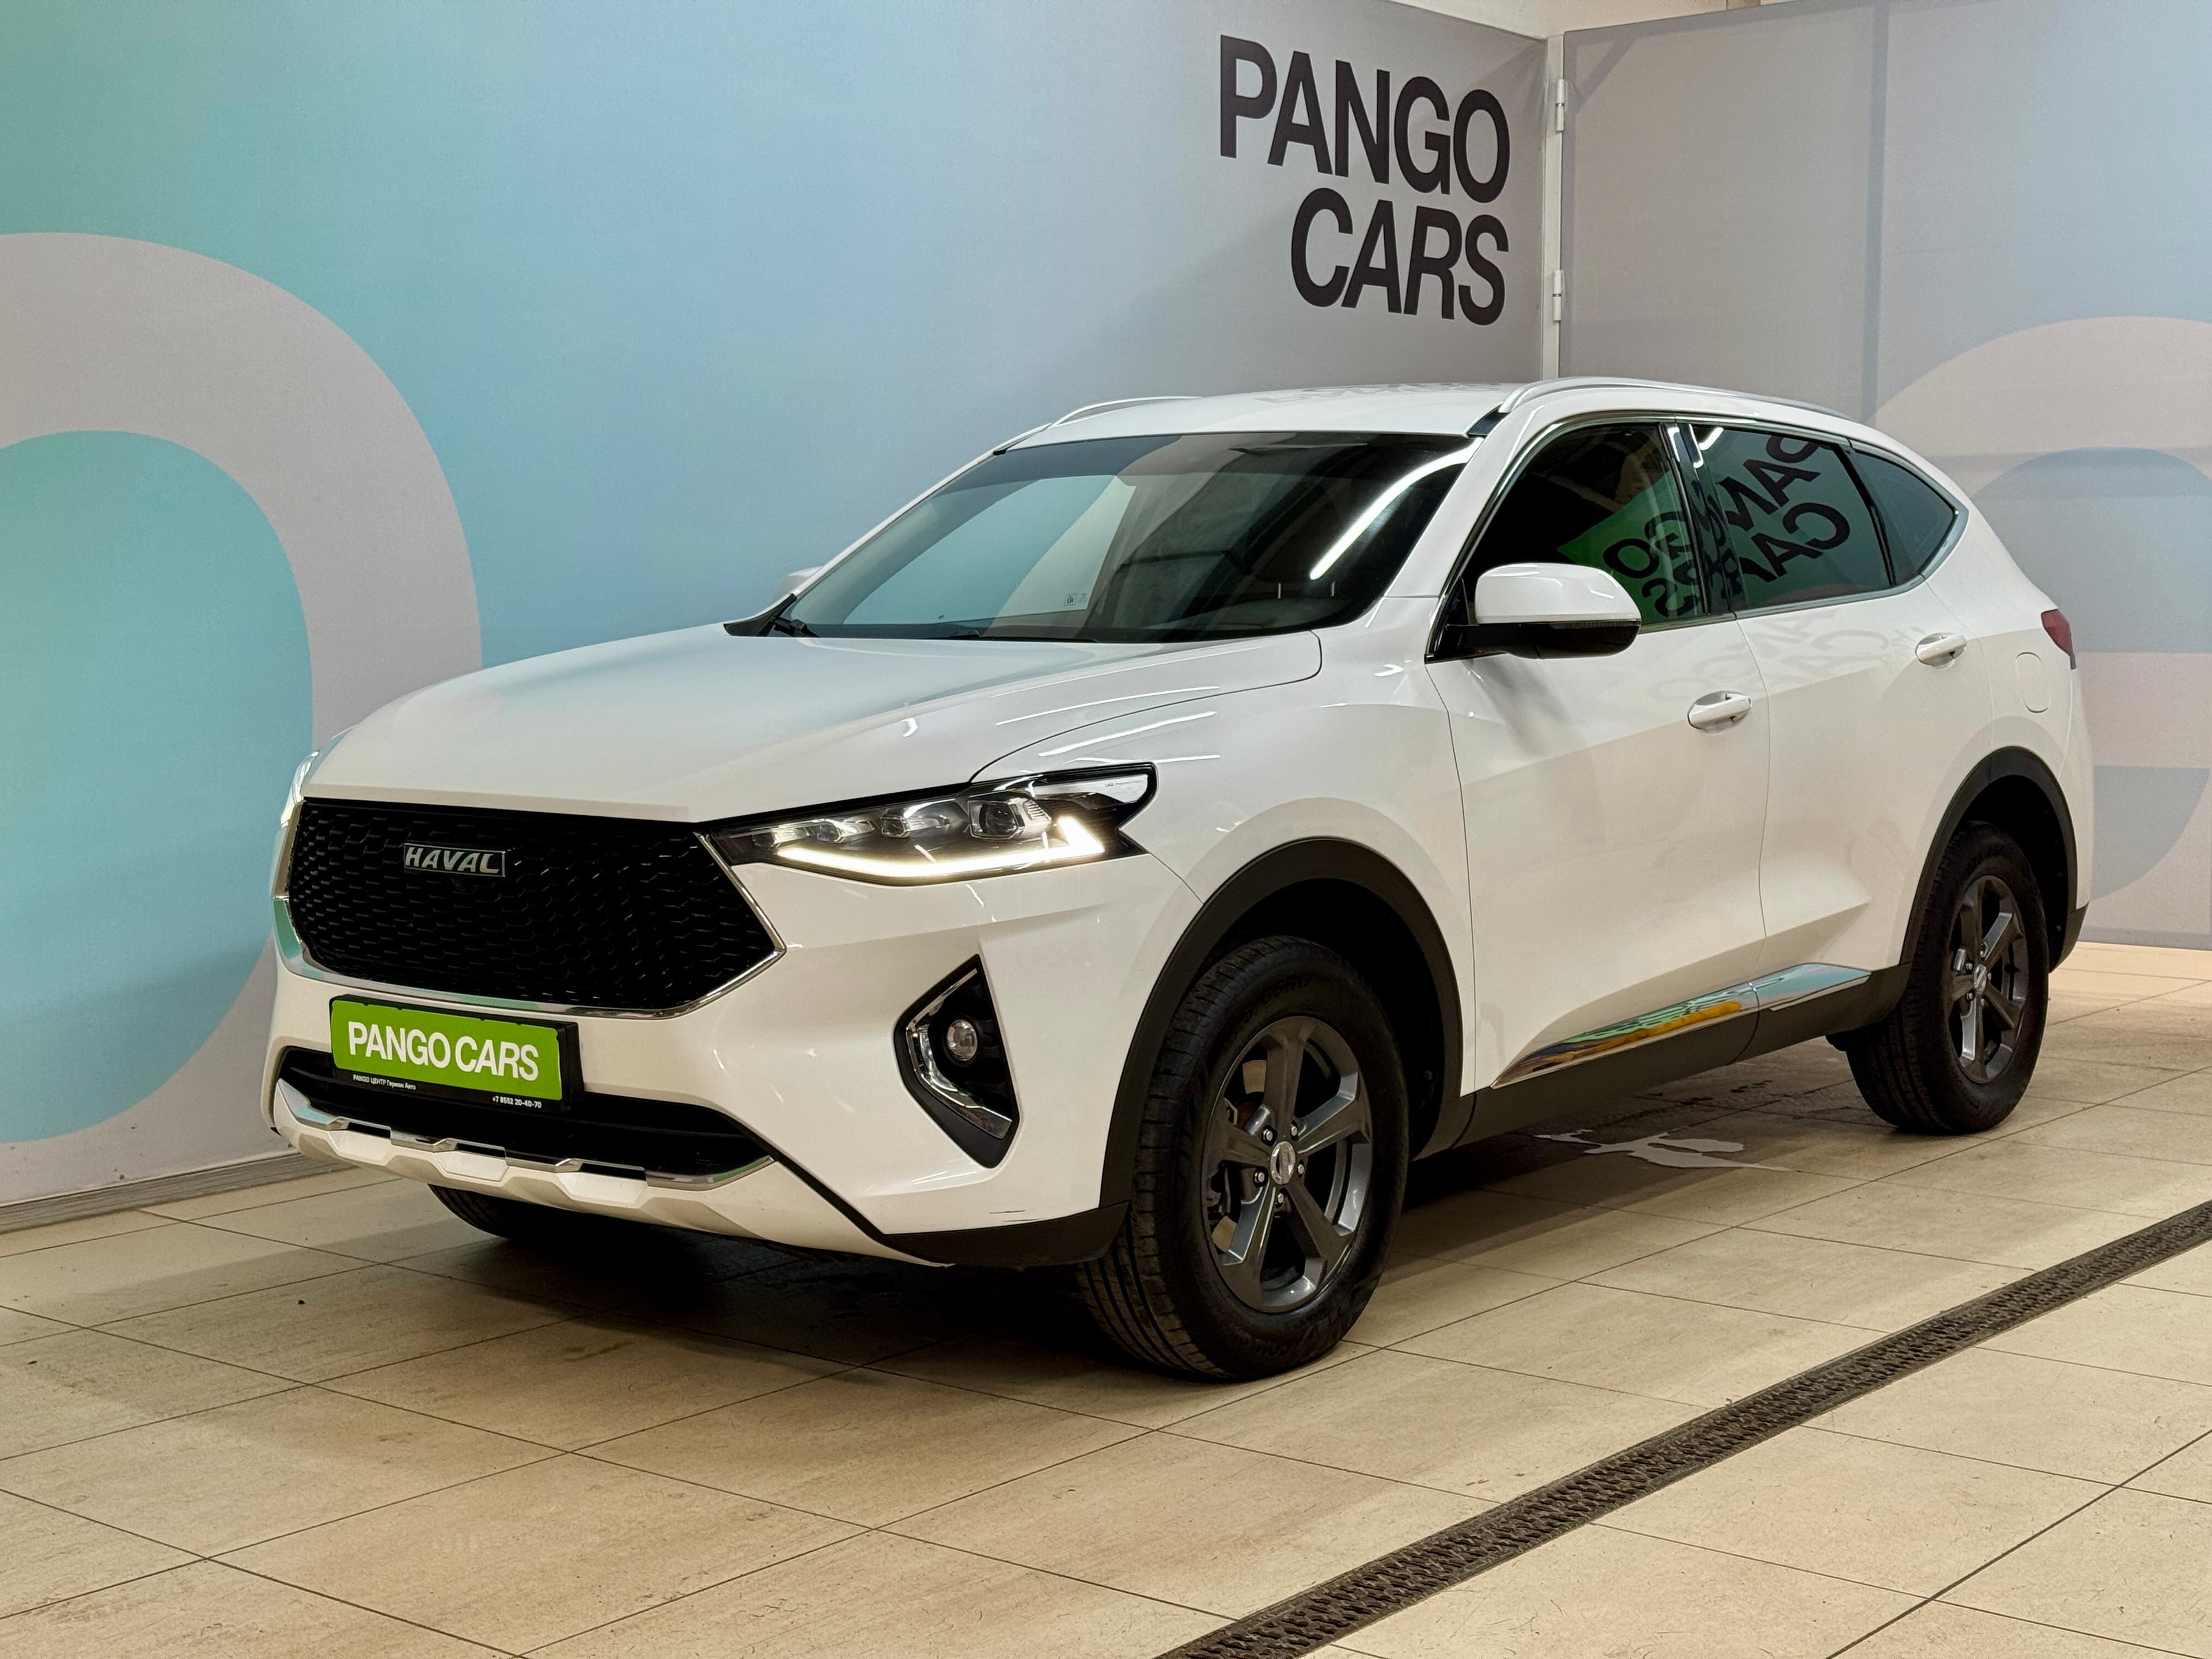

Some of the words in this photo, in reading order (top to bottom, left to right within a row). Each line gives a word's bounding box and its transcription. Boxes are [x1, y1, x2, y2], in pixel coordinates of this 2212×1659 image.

[1220, 35, 1510, 203] PANGO
[1291, 188, 1509, 326] CARS
[405, 847, 499, 874] HAVAL
[348, 1021, 451, 1069] PANGO
[455, 1036, 539, 1081] CARS
[353, 1074, 370, 1084] PANGO
[370, 1077, 386, 1086] ЦЕНТР
[404, 1082, 416, 1090] Авто
[499, 1096, 514, 1105] 8552
[514, 1099, 542, 1108] 20-40-70
